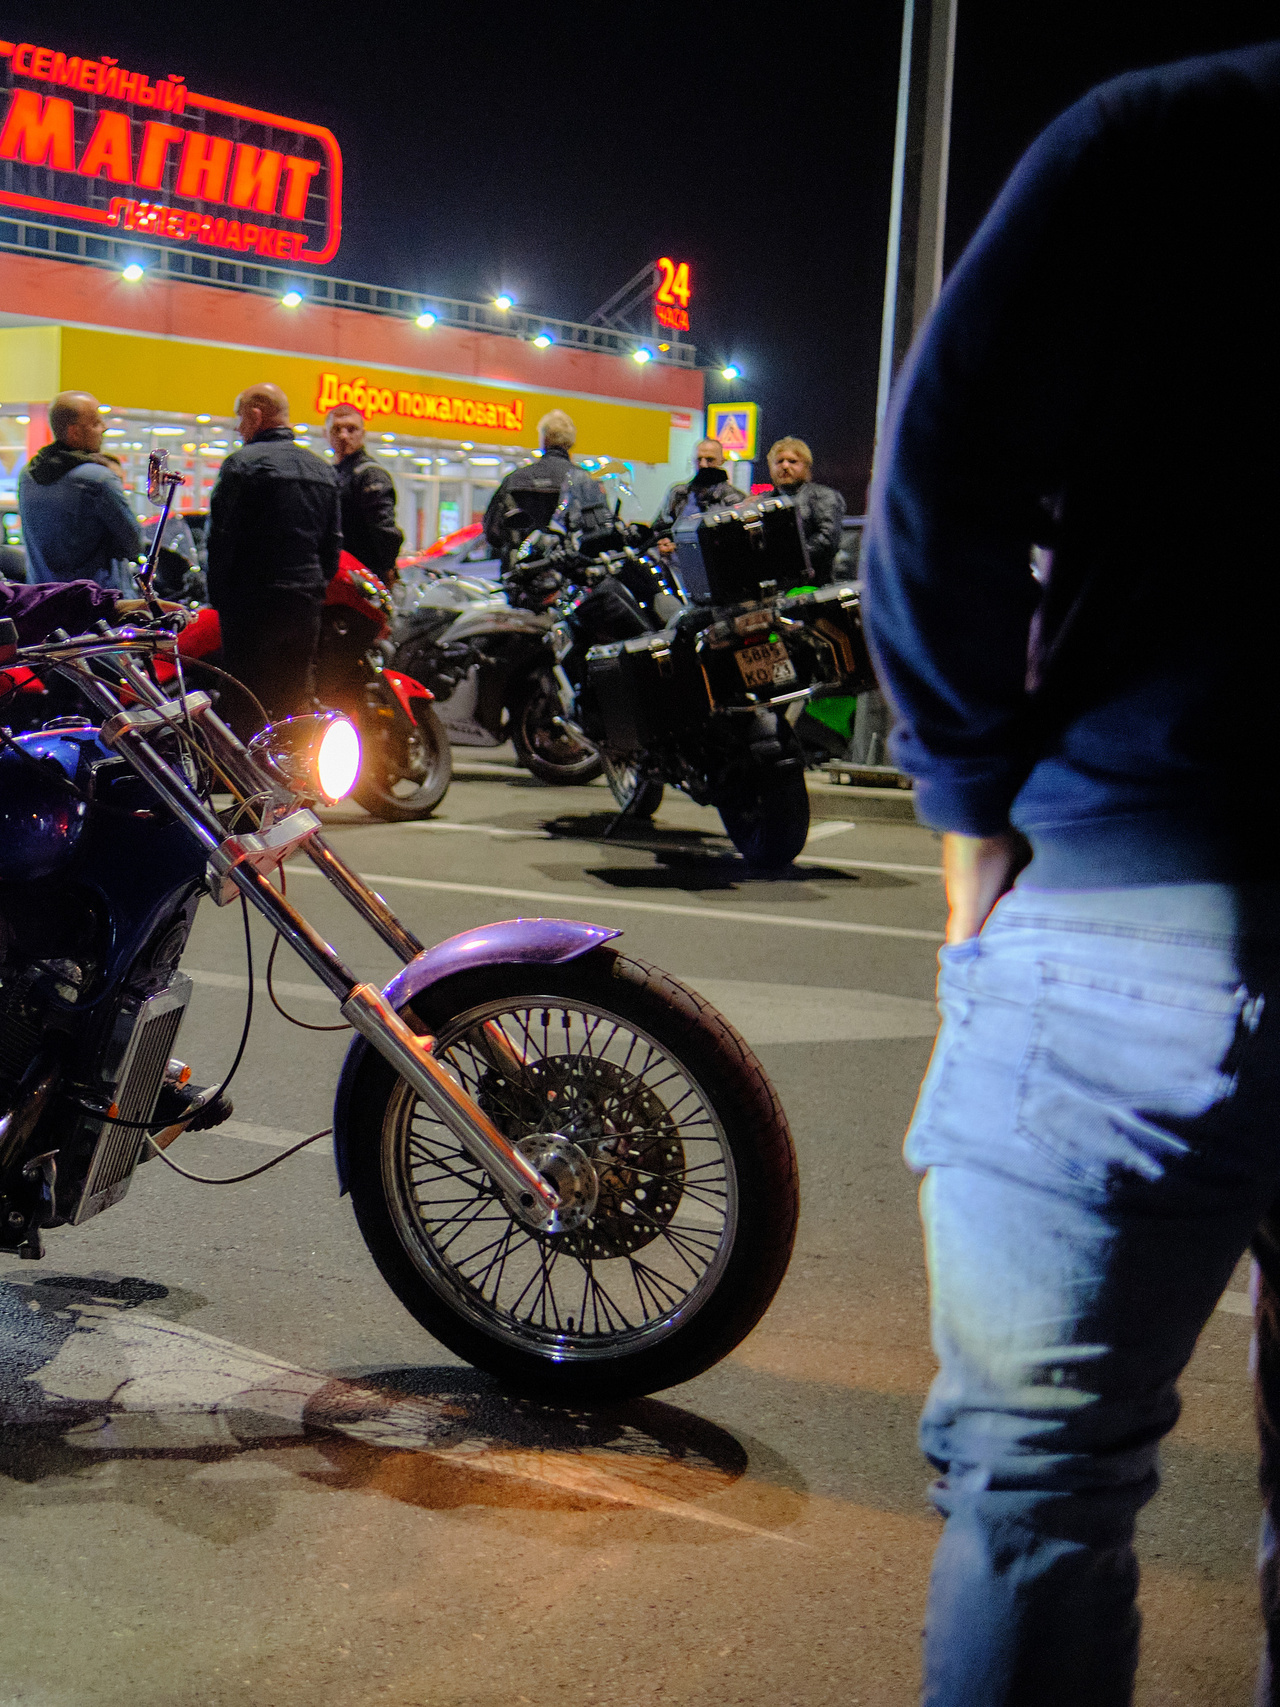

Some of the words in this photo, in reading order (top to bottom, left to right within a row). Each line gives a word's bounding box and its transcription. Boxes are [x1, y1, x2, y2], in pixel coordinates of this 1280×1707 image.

[11, 43, 188, 114] СЕМЕЙНЫЙ
[108, 197, 309, 260] ГИПЕРМАРКЕТ
[657, 257, 691, 308] 24
[317, 372, 395, 421] Добро
[395, 389, 524, 431] пожаловать!
